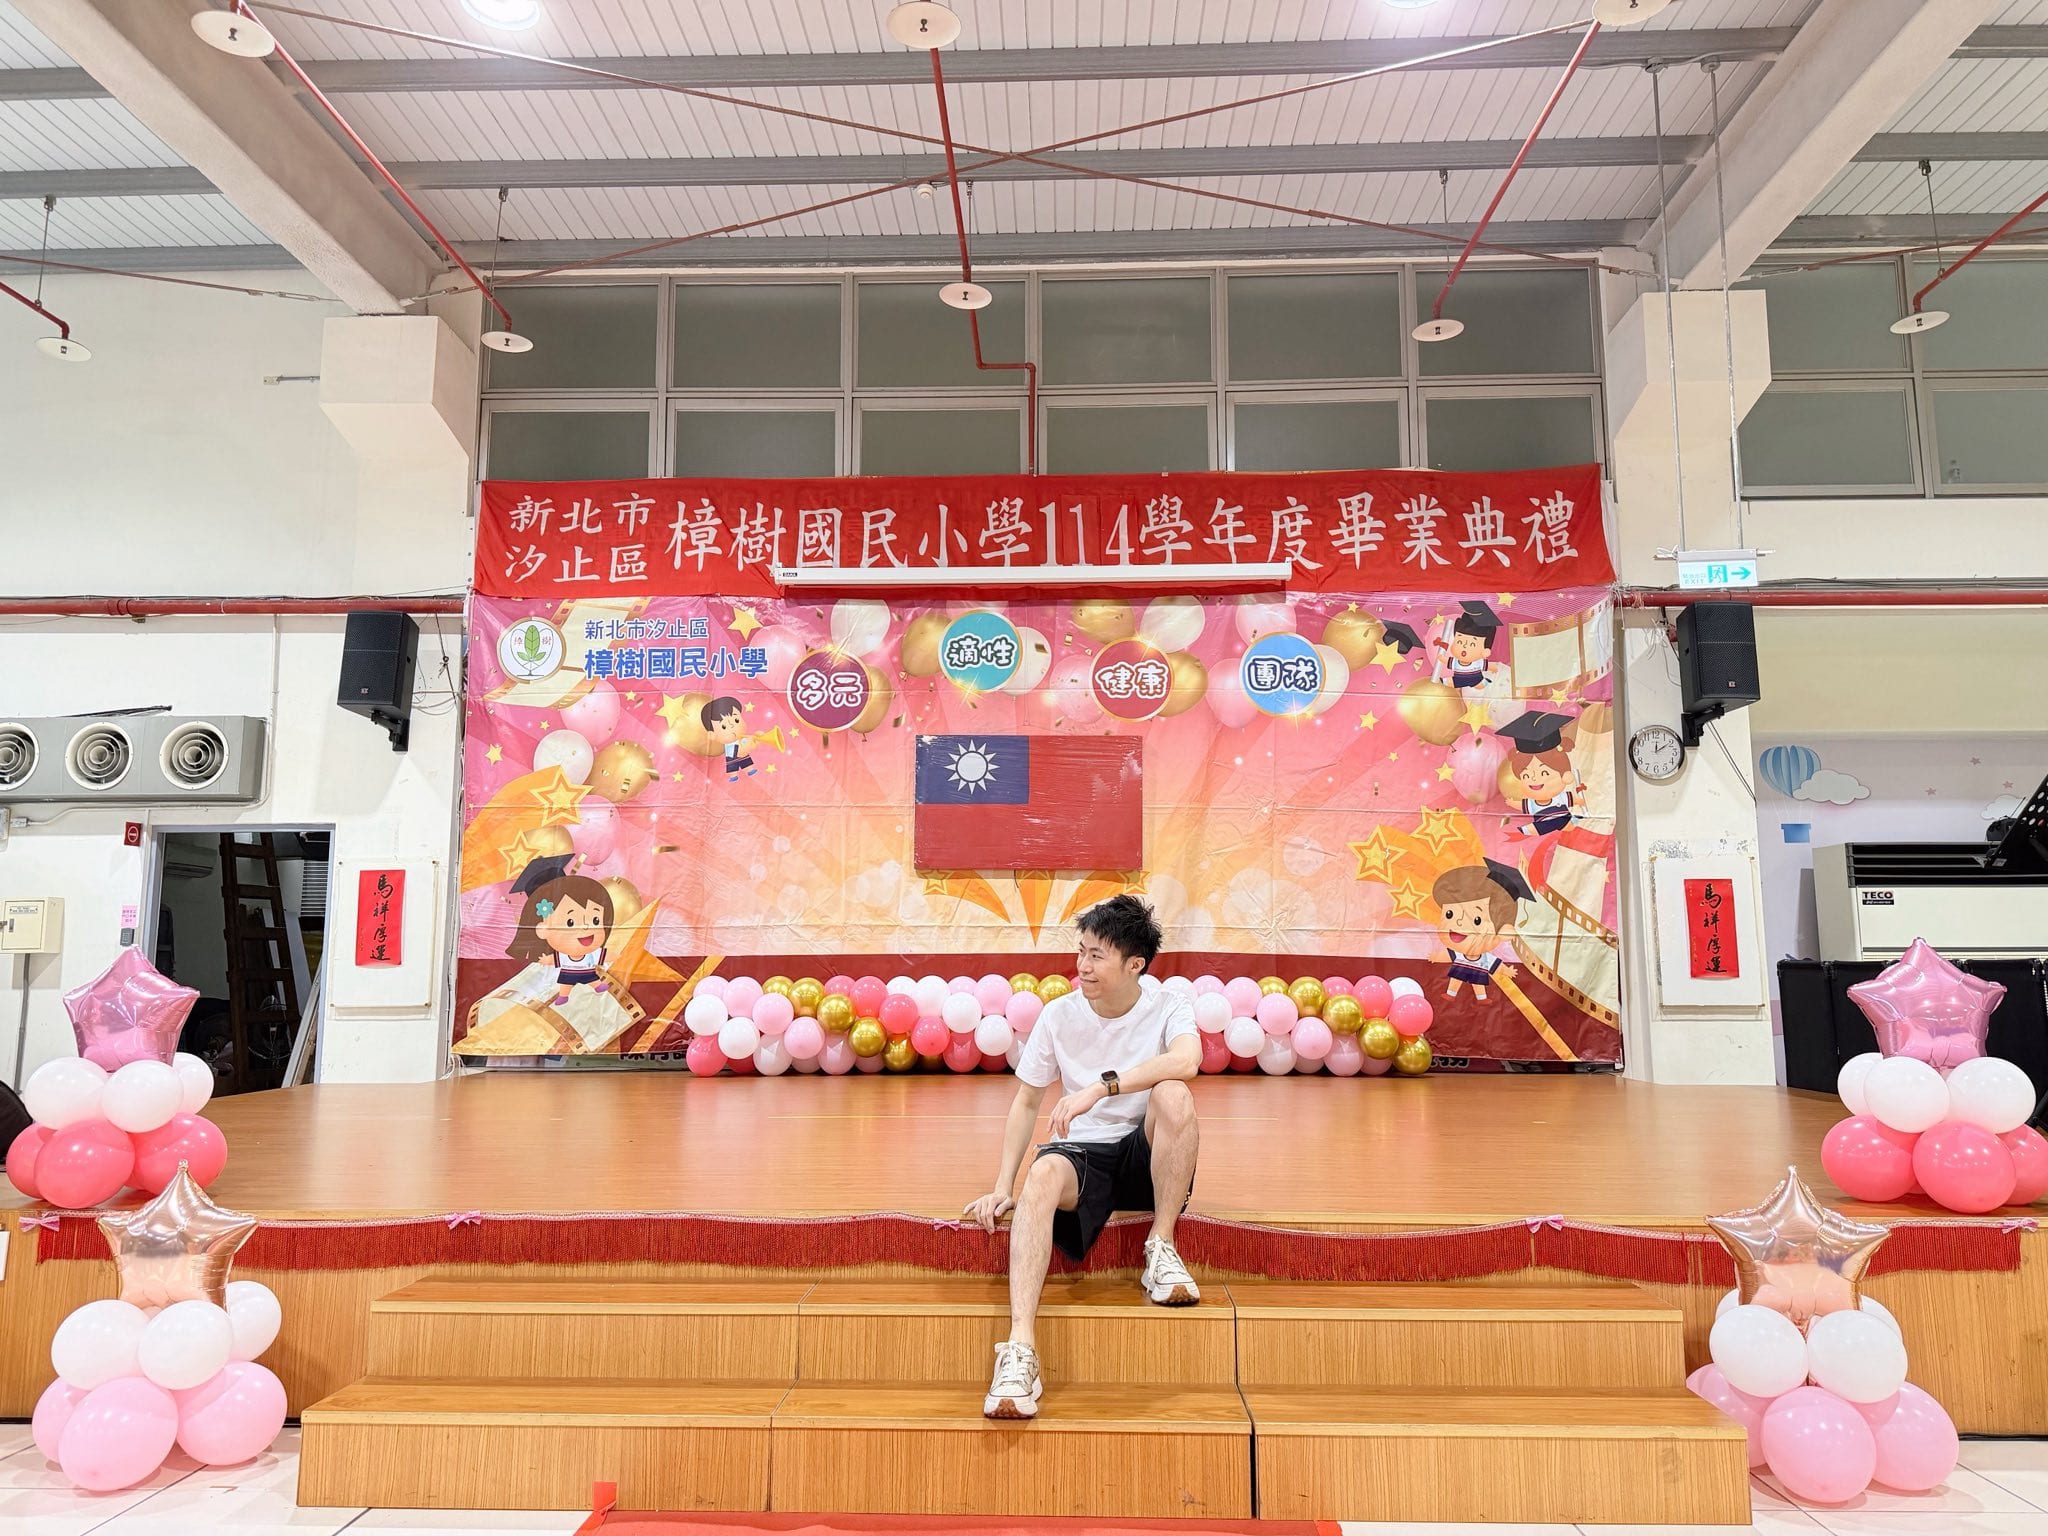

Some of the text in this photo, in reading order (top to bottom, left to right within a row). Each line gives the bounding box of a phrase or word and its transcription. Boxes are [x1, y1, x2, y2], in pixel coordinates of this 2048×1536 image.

[508, 492, 656, 536] 新北市
[505, 543, 649, 584] 汐止區
[584, 618, 709, 640] 新北市汐止區
[584, 647, 768, 679] 樟樹國民小學
[946, 633, 1018, 669] 適性
[797, 670, 864, 710] 多元
[1096, 659, 1168, 698] 健康
[1246, 655, 1321, 693] 團隊
[1862, 891, 1893, 899] TECO
